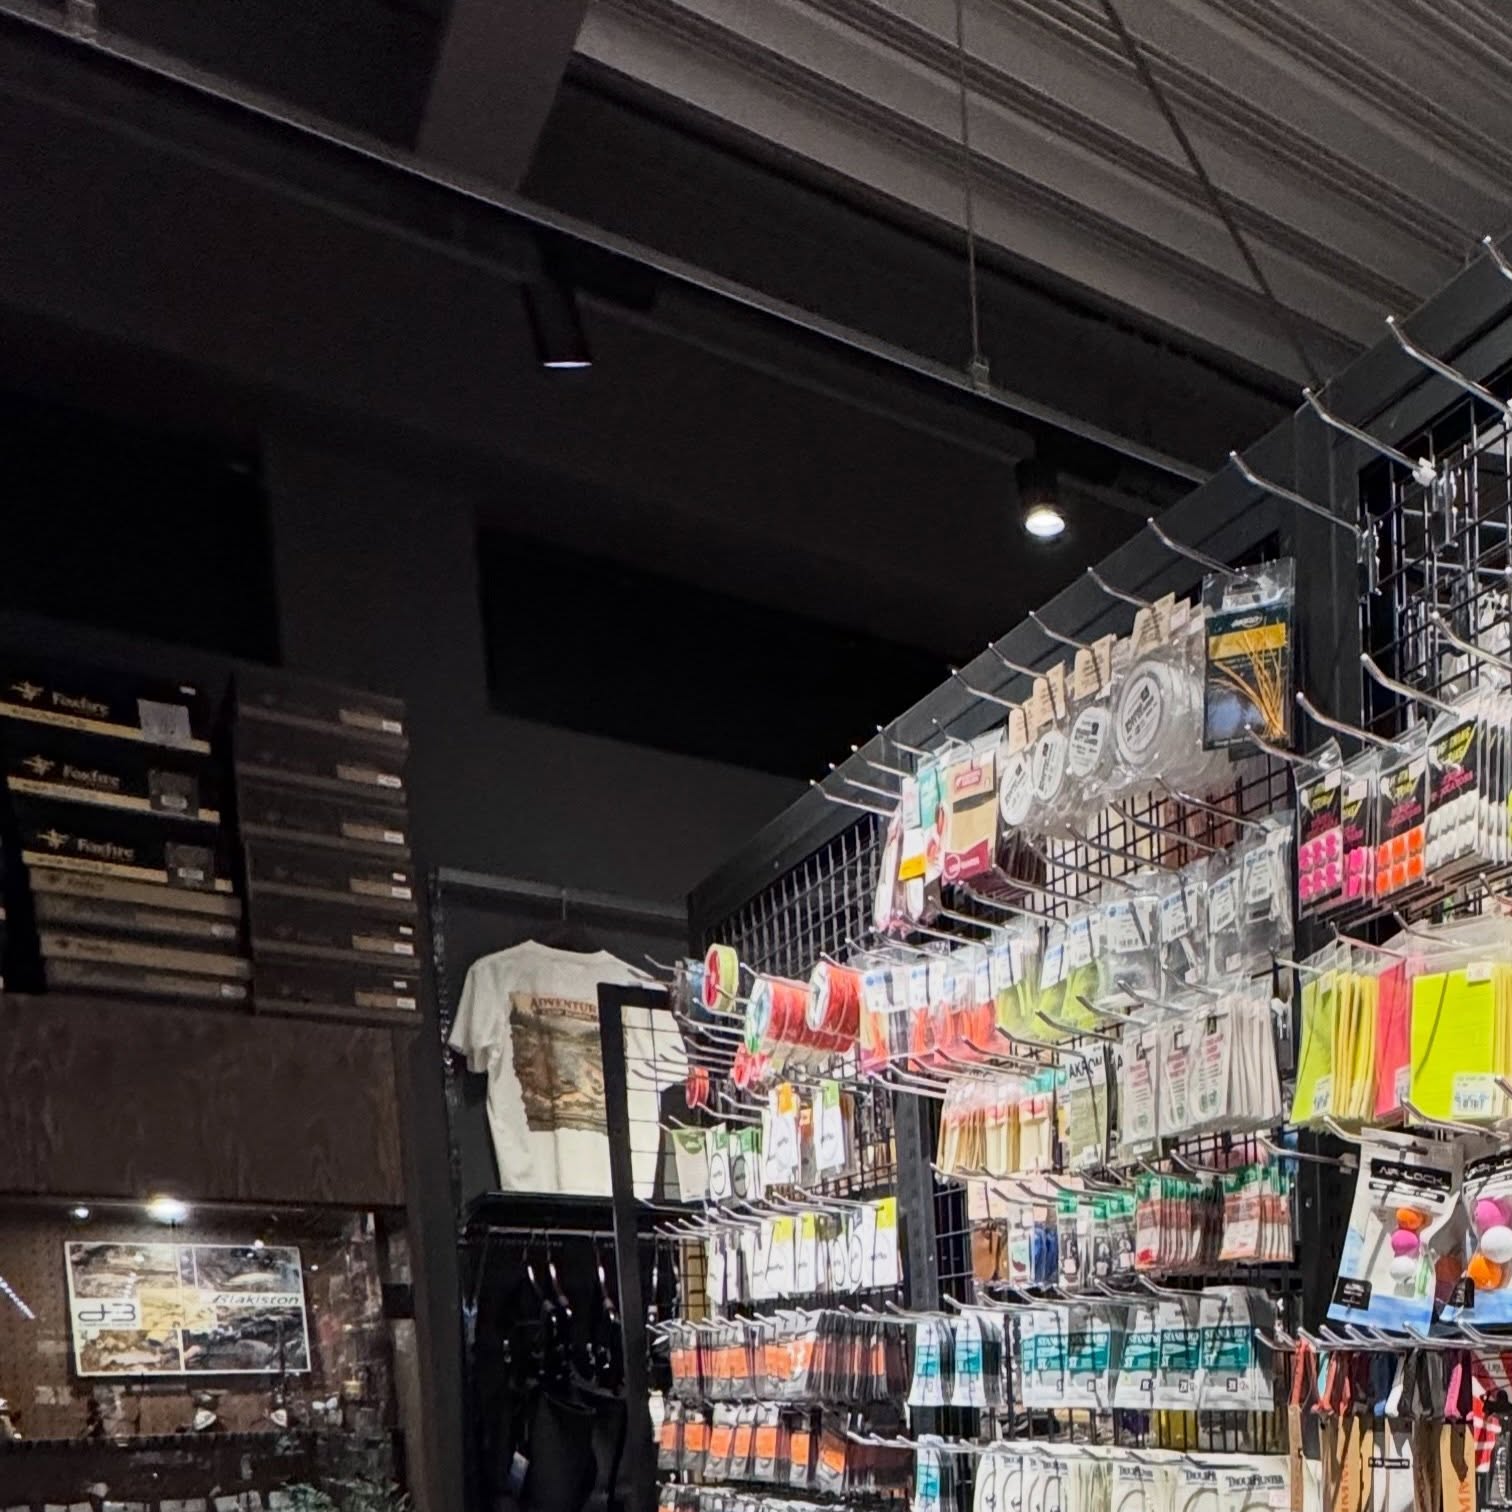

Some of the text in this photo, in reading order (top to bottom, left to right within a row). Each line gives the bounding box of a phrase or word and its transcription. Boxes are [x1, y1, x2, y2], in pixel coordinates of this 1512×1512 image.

[62, 763, 121, 789] Foxfire
[76, 837, 135, 862] Foxfire
[530, 997, 598, 1013] ADVENTUR
